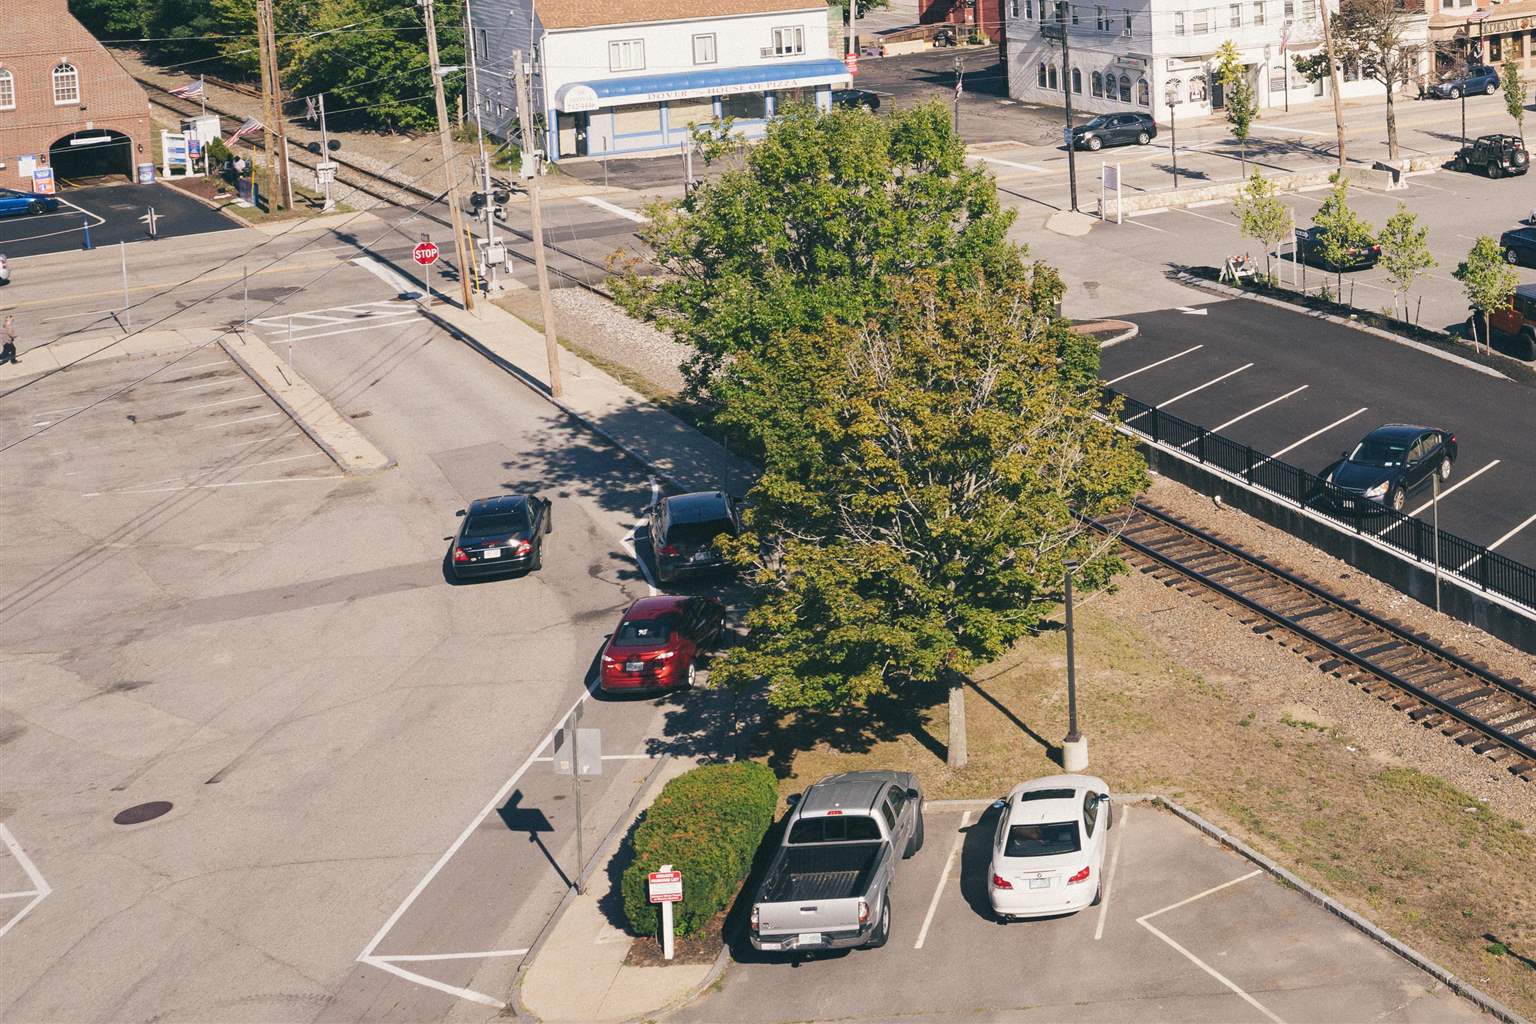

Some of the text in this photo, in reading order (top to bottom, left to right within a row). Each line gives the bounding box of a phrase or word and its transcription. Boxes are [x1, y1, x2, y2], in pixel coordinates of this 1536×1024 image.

[648, 91, 688, 100] DOVER
[707, 86, 742, 94] HOUSE
[766, 80, 798, 88] PIZZA
[415, 249, 437, 259] STOP
